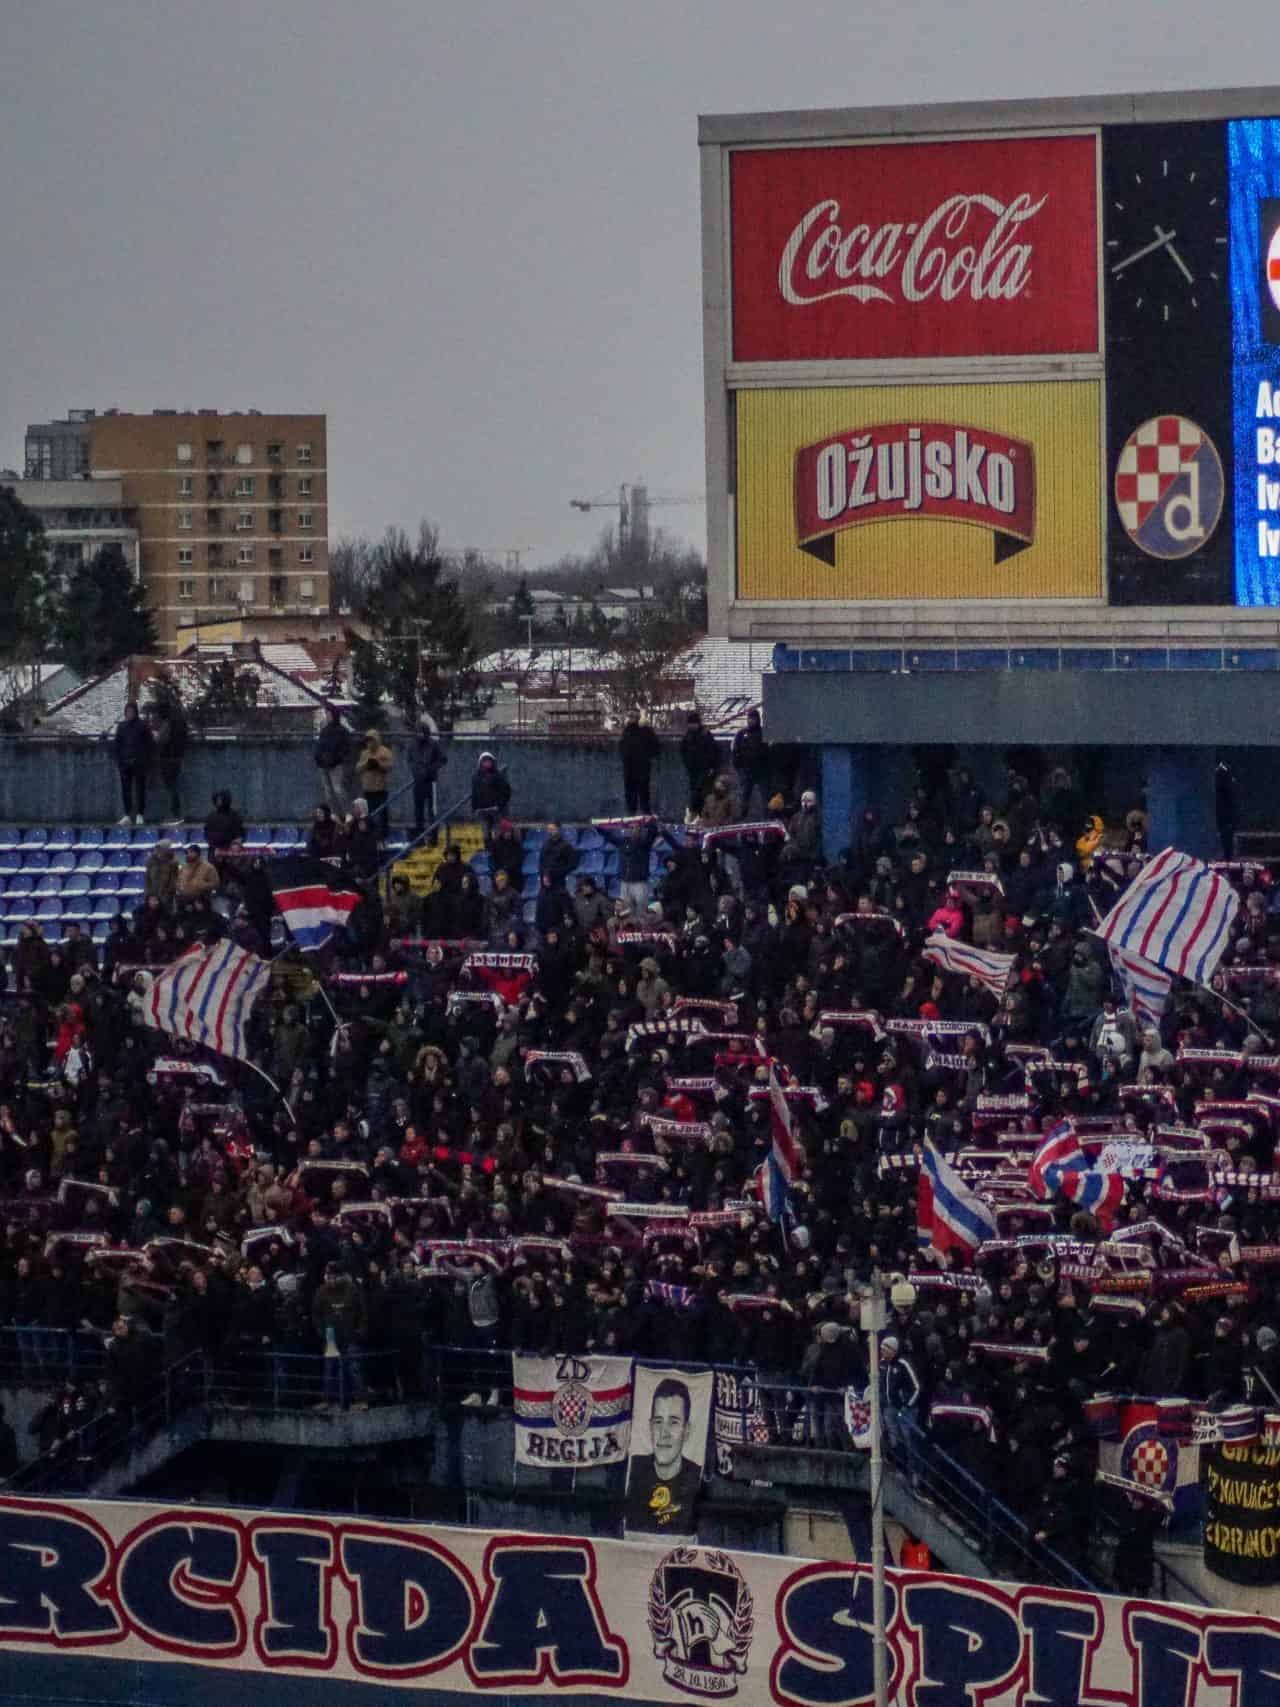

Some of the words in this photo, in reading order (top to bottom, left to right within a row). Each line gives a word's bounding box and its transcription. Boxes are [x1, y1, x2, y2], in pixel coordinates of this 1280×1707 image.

[778, 193, 1048, 305] Coca-Cola
[816, 428, 1015, 520] Ožujsko
[554, 1354, 591, 1382] ZD
[526, 1432, 622, 1463] REGIJA
